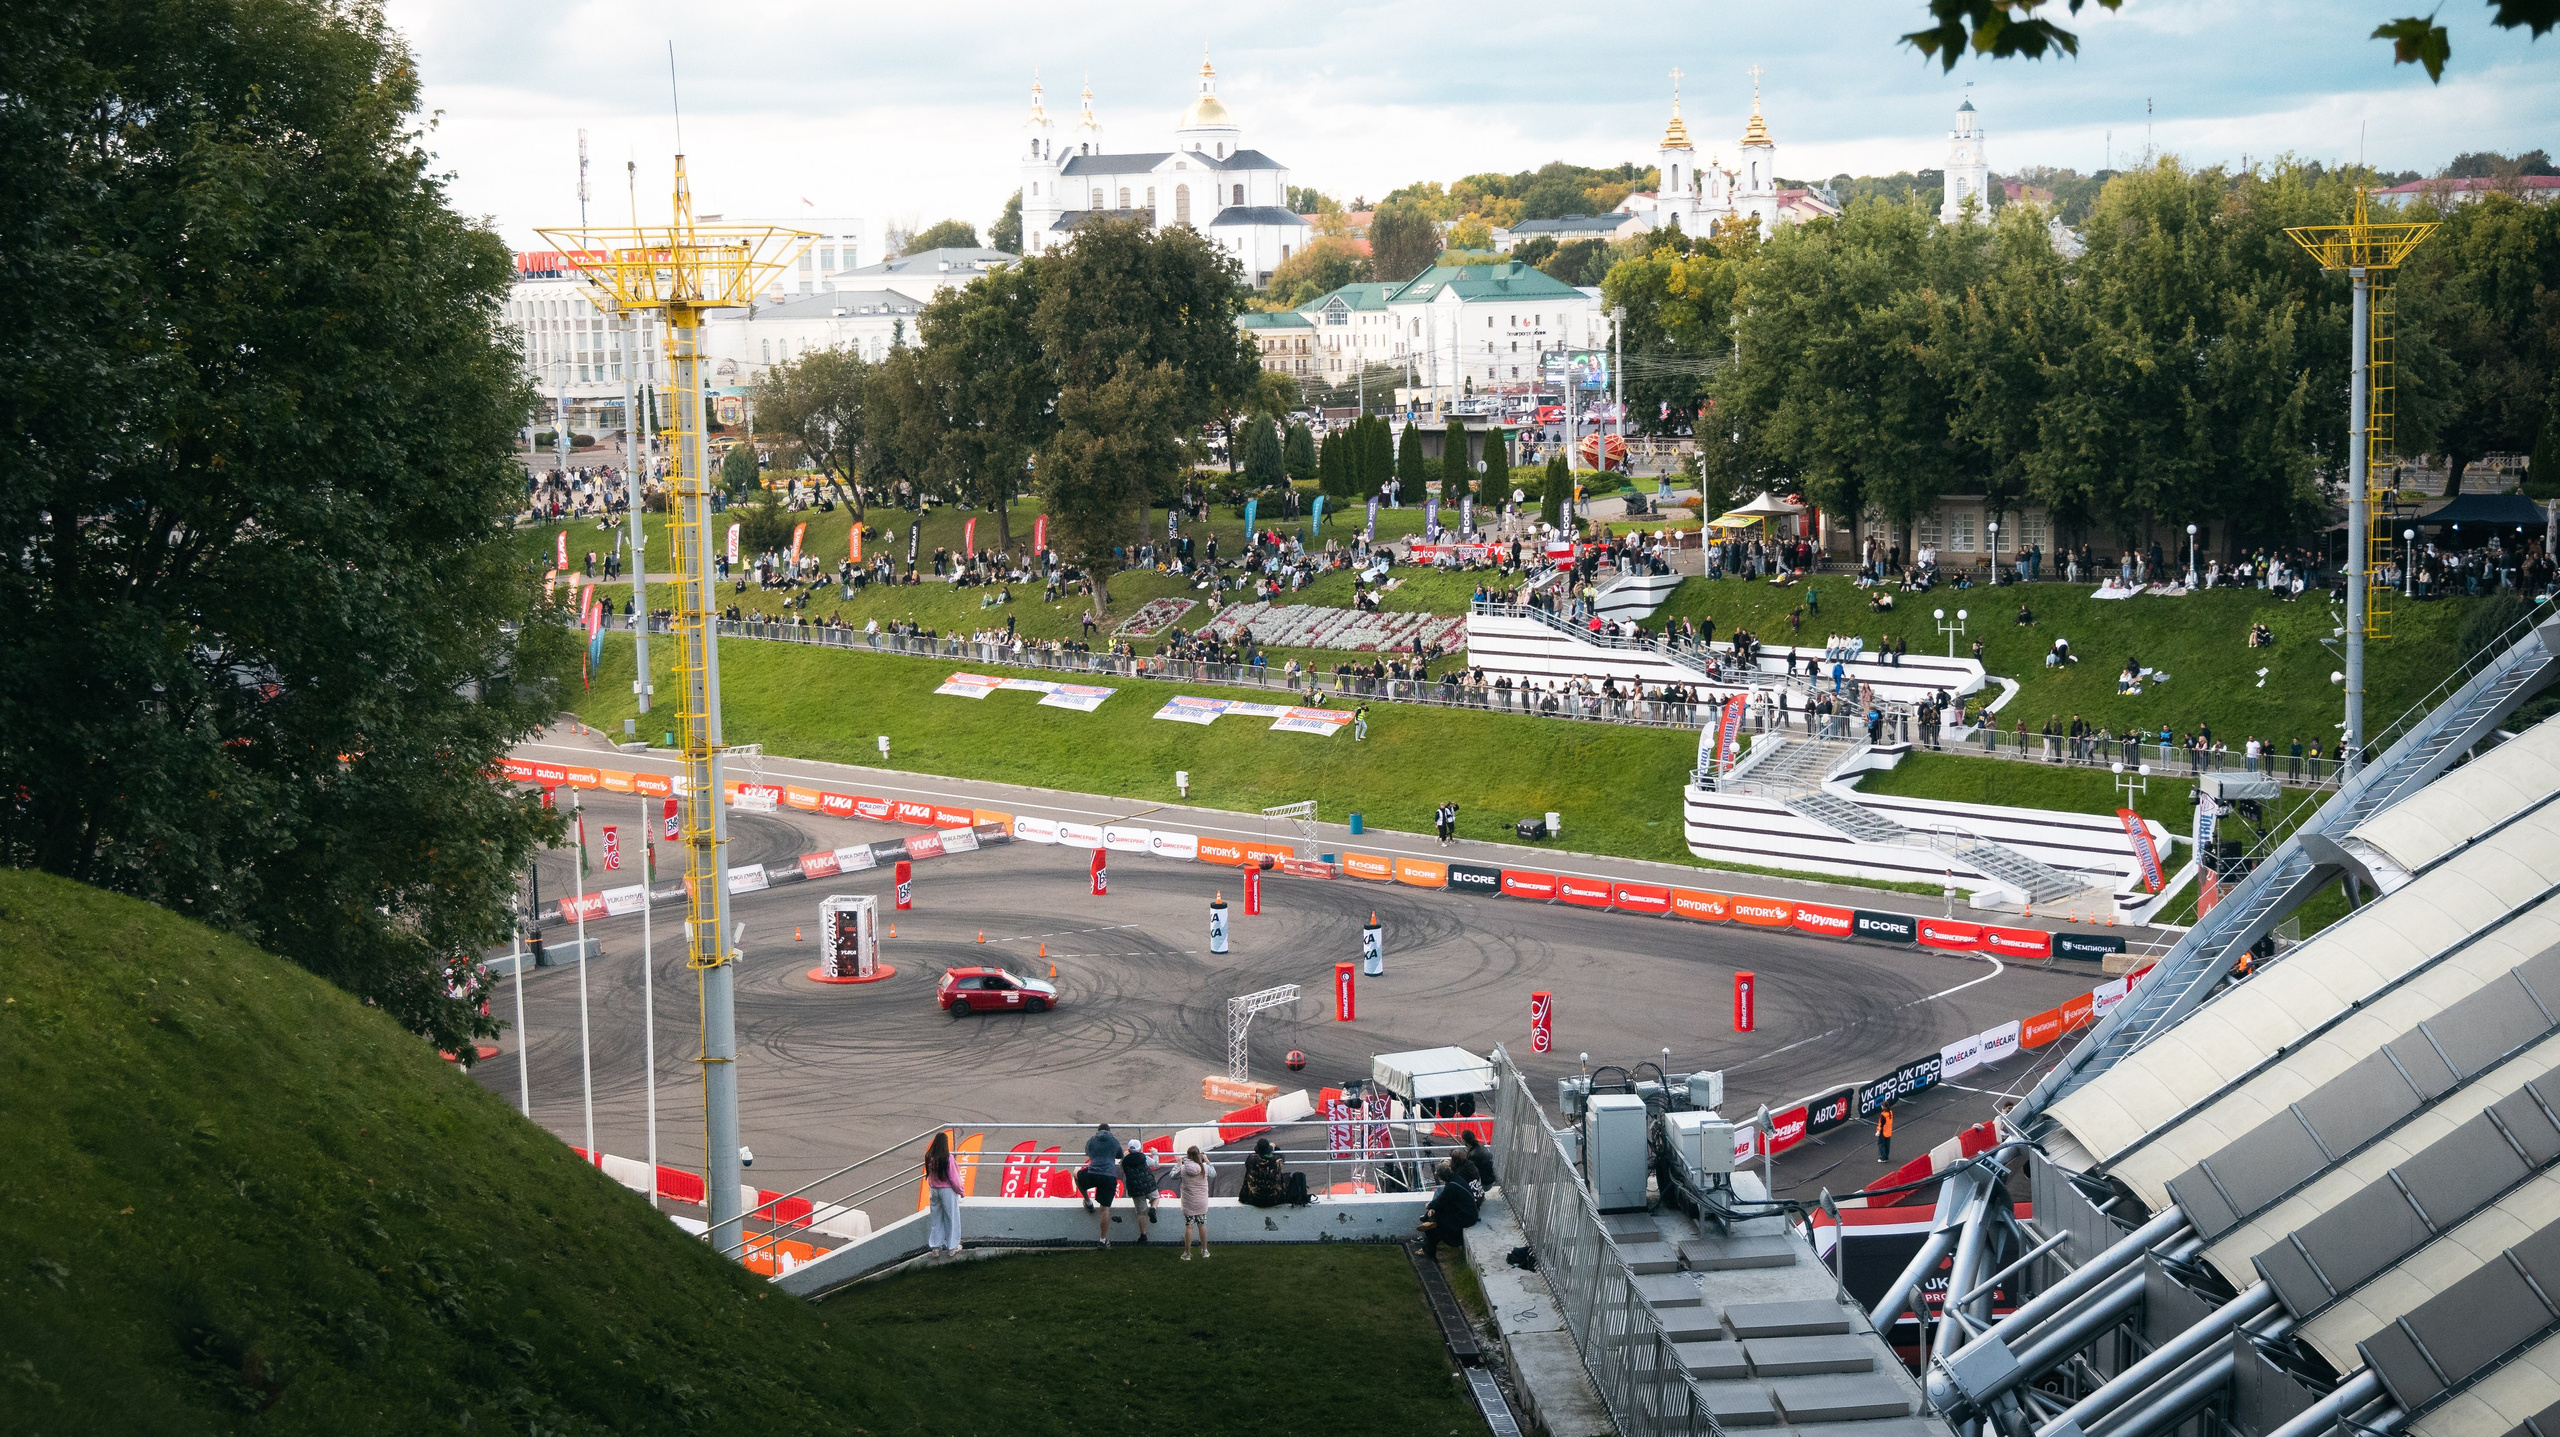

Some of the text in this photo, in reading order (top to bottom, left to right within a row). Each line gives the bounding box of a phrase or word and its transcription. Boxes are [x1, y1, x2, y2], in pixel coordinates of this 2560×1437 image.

[558, 535, 566, 564] YUKA
[730, 530, 739, 558] YUKA
[536, 769, 565, 781] auto.ru
[823, 795, 852, 809] YUKA
[899, 803, 931, 819] YUKA
[911, 838, 940, 851] YUKA
[806, 857, 836, 870] YUKA
[2072, 943, 2117, 954] ЧЕМПИОНАТ
[1915, 1059, 1941, 1077] ПРО
[1861, 1077, 1898, 1103] VK ПРО
[1897, 1071, 1940, 1094] СПОРТ
[1861, 1088, 1897, 1114] СПОРТ
[1337, 1105, 1351, 1152] YUKA
